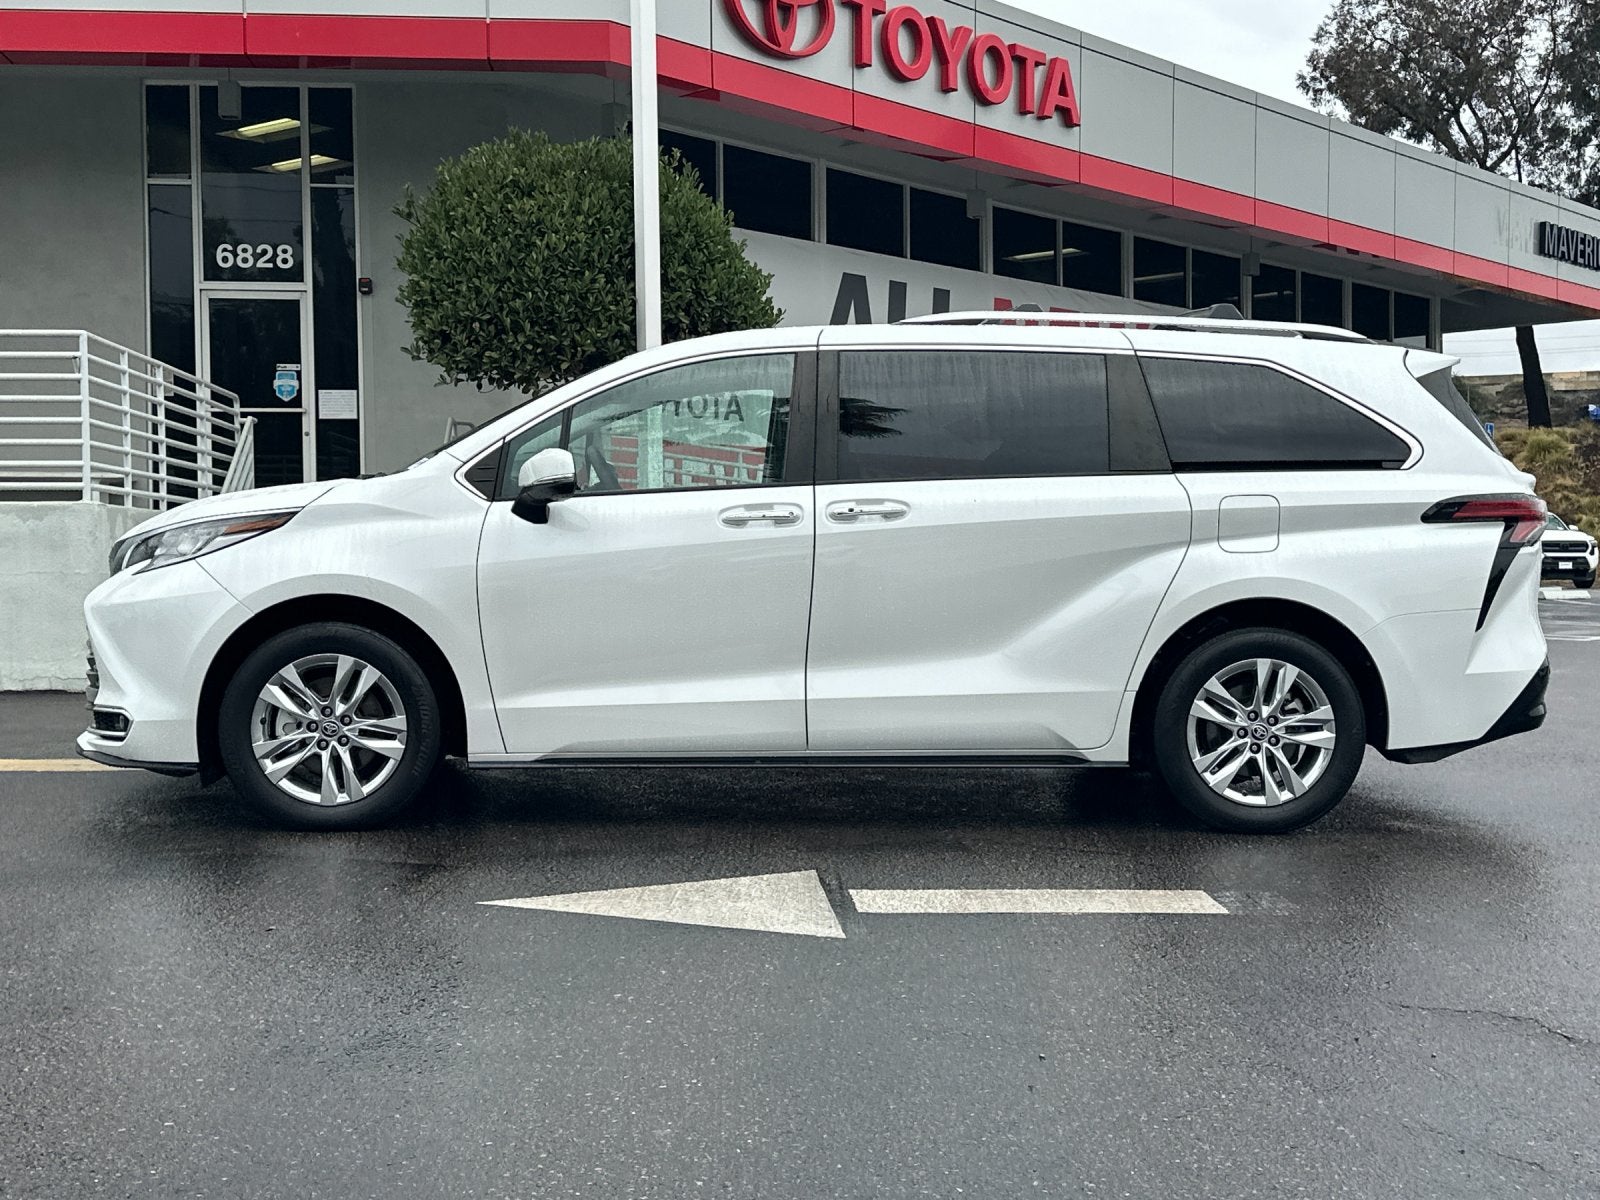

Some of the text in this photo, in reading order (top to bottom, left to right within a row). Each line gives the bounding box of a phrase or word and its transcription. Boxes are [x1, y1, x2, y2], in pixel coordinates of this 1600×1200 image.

[842, 0, 1081, 127] TOYOTA
[216, 243, 294, 269] 6828
[1541, 221, 1600, 271] MAVERI
